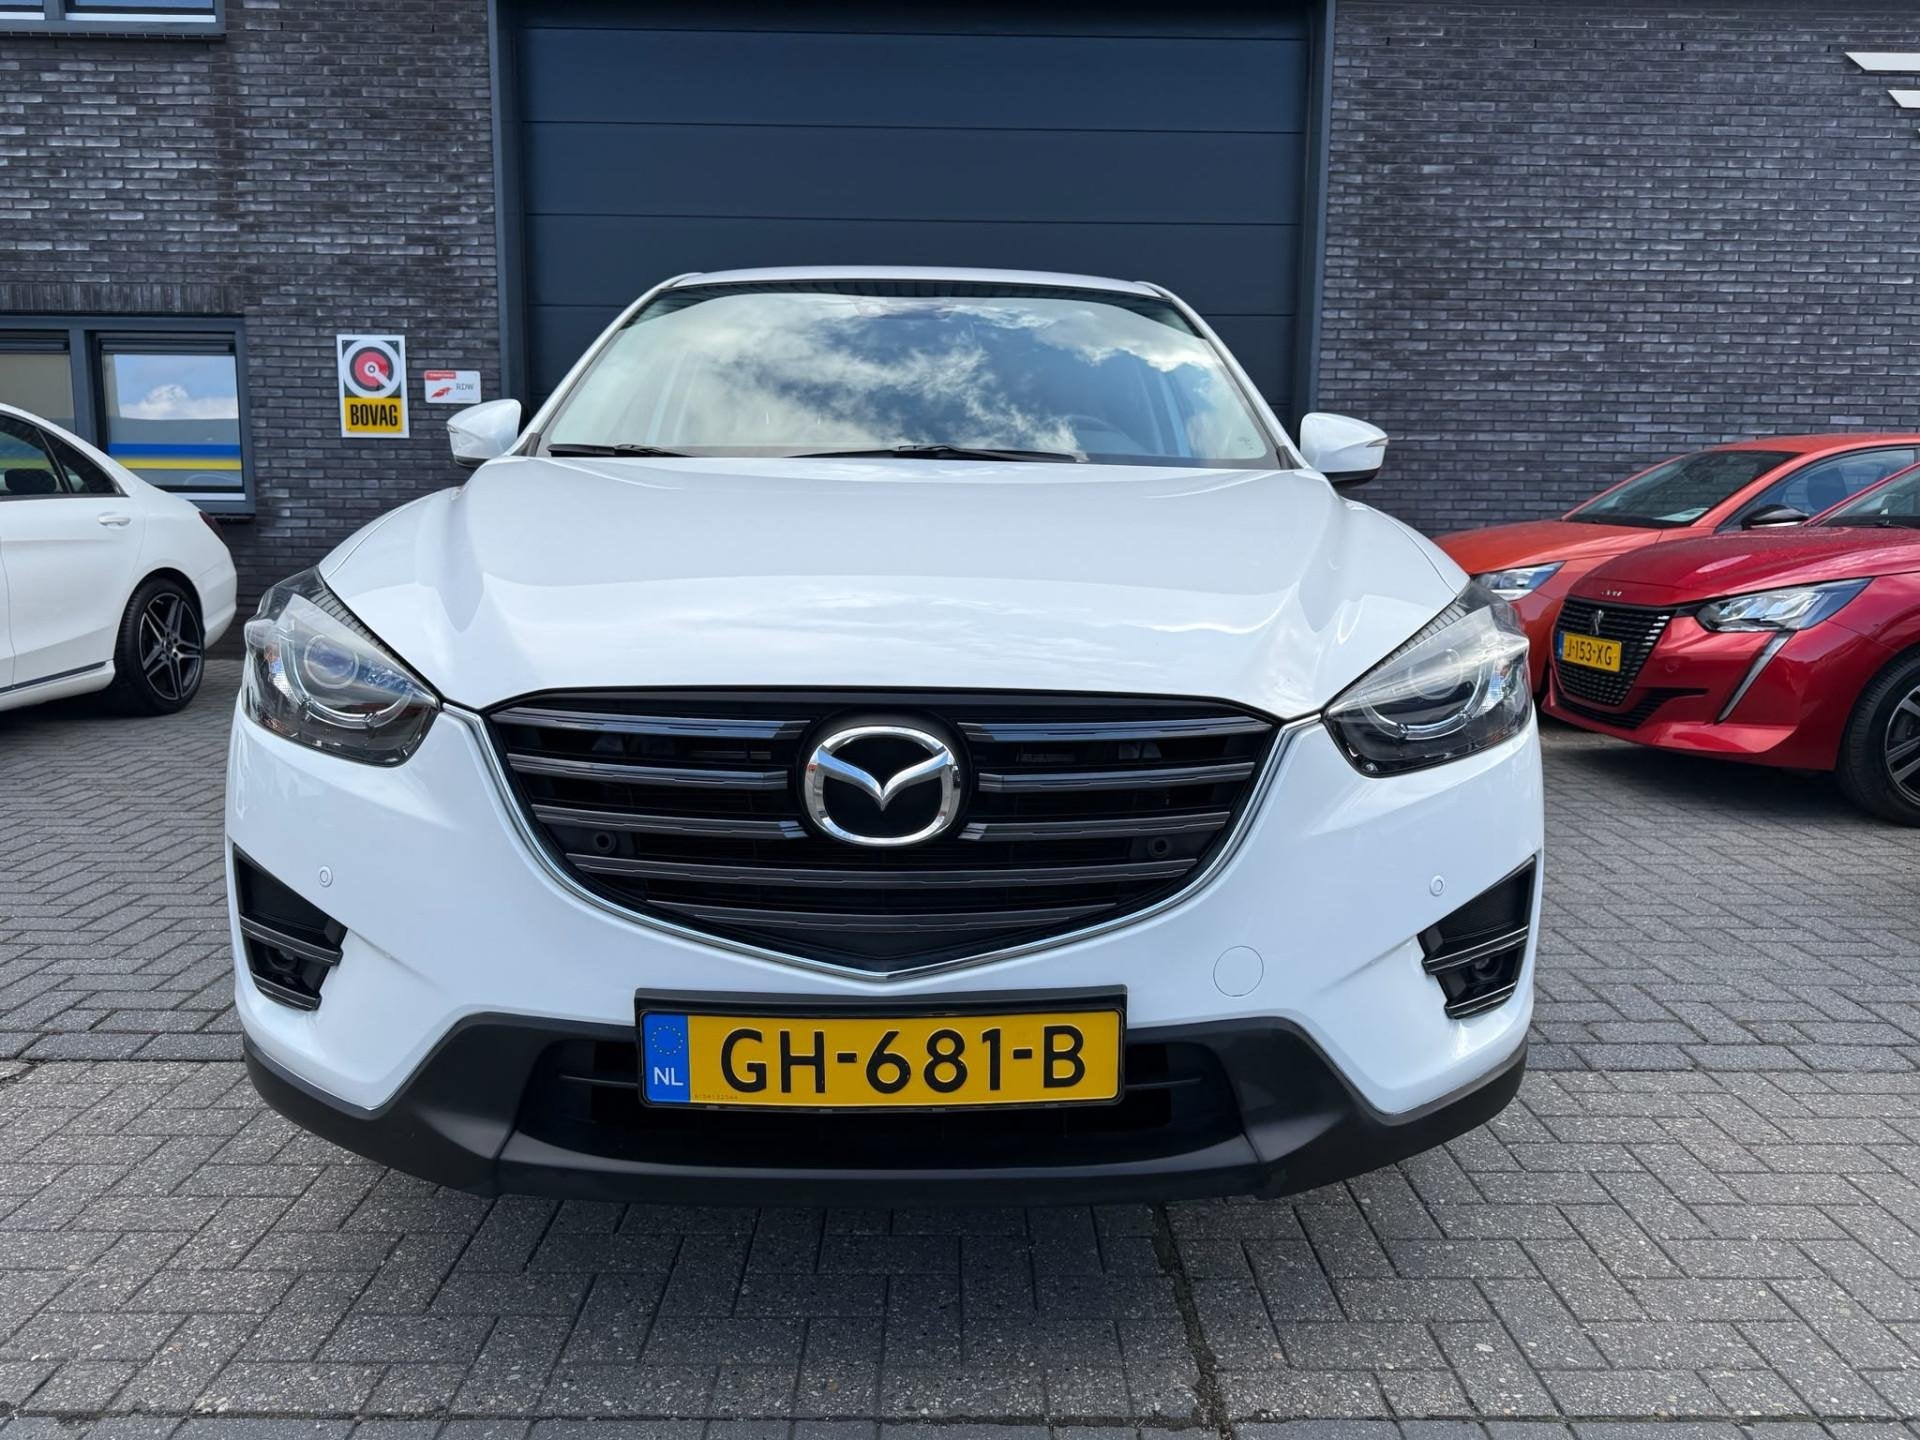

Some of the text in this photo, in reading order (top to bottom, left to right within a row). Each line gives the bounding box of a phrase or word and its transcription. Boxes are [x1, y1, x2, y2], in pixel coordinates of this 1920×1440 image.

[350, 403, 398, 426] BOVAG
[1566, 639, 1612, 665] J-153-XG
[720, 1025, 1086, 1094] GH-681-B
[653, 1066, 684, 1086] NL
